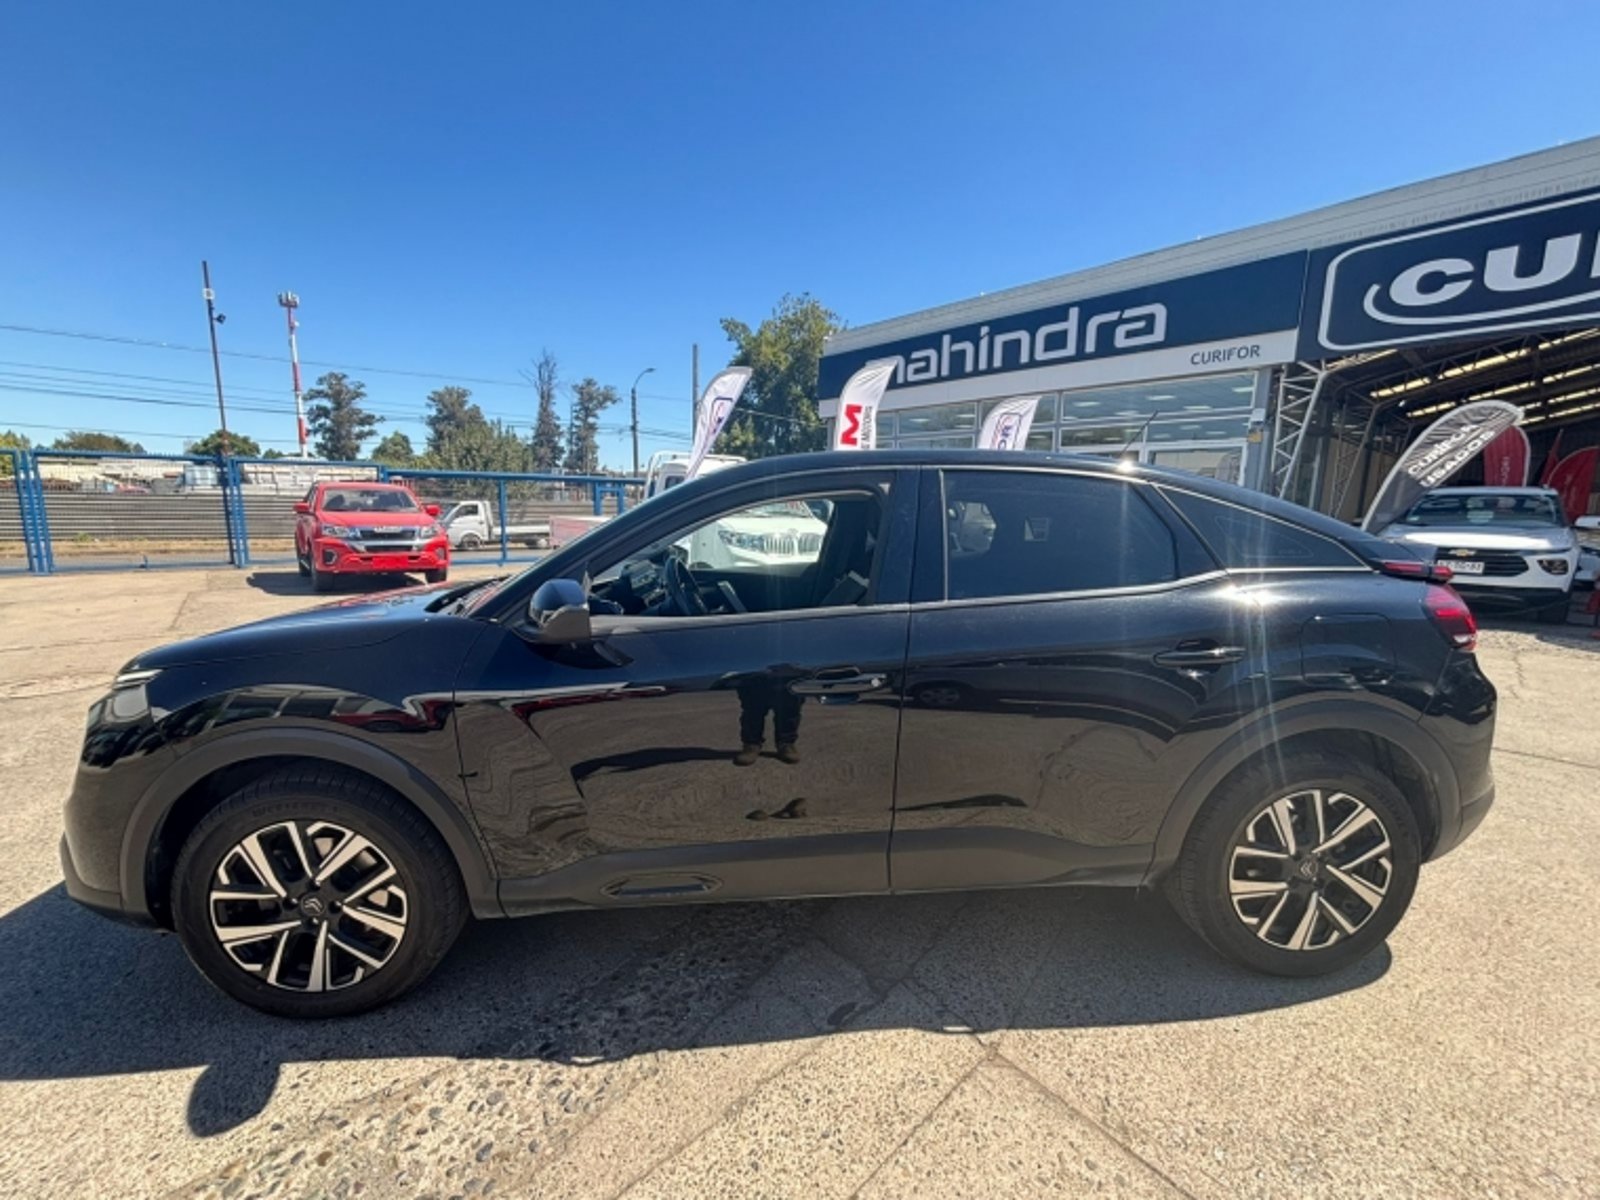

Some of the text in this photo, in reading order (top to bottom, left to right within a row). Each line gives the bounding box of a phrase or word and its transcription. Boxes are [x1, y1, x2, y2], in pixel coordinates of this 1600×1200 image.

[1388, 232, 1600, 307] CU
[1190, 344, 1260, 365] CURIFOR
[1419, 429, 1496, 488] USADOS
